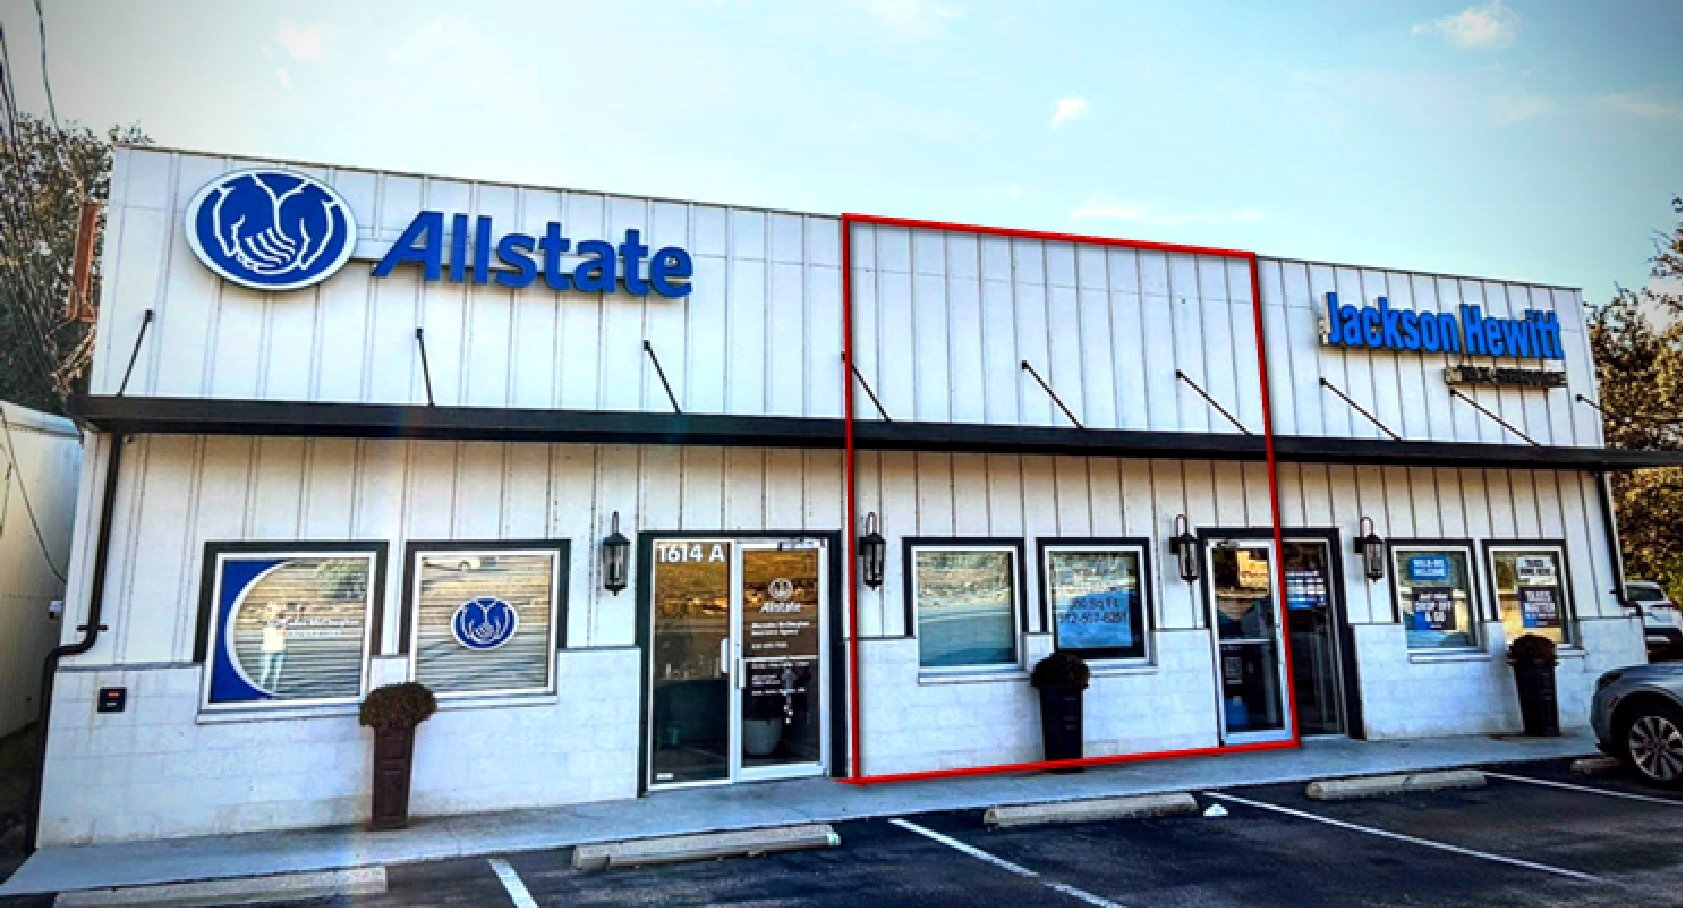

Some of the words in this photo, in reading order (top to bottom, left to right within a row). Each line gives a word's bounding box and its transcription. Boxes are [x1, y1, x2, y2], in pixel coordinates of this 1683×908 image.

[371, 210, 693, 298] Allstate
[1326, 291, 1461, 353] Jackson
[1460, 304, 1565, 360] Hewitt
[656, 543, 703, 562] 1614
[708, 543, 726, 562] A
